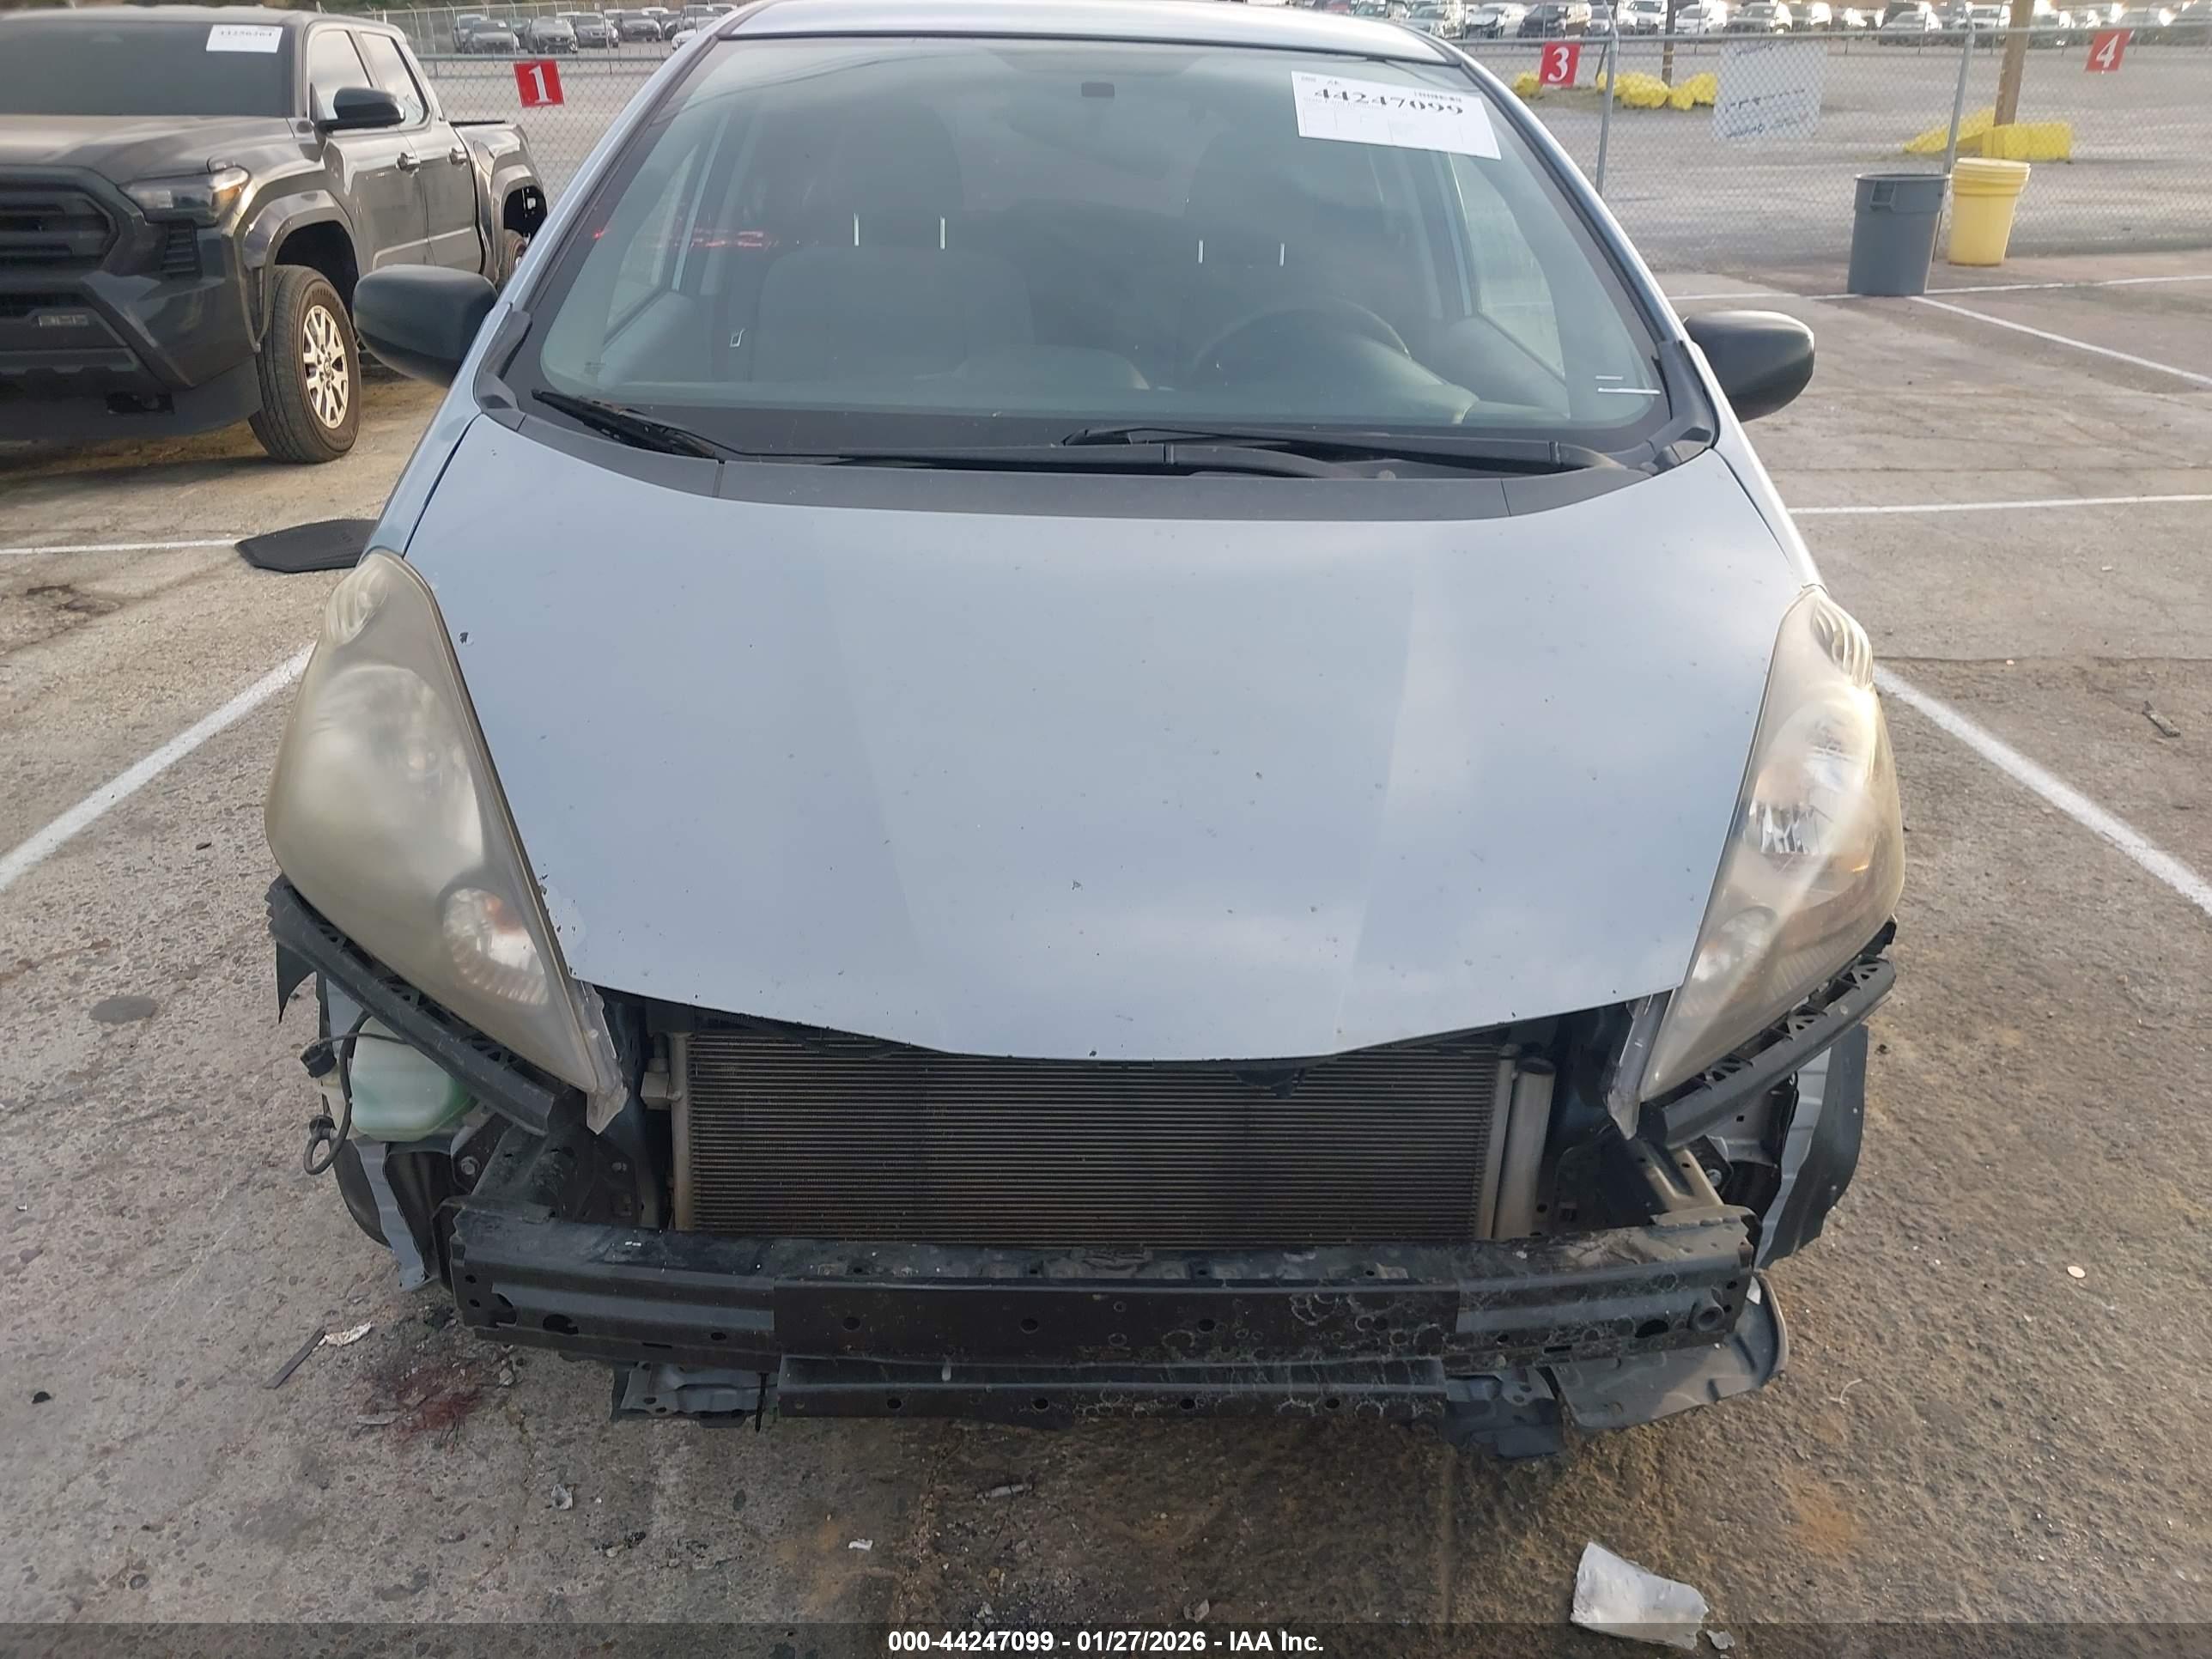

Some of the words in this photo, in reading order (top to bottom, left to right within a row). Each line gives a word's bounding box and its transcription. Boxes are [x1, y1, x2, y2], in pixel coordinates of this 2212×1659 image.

[1547, 46, 1570, 82] 3
[2095, 33, 2120, 69] 4
[528, 64, 553, 104] 1
[1314, 88, 1463, 115] 44247099
